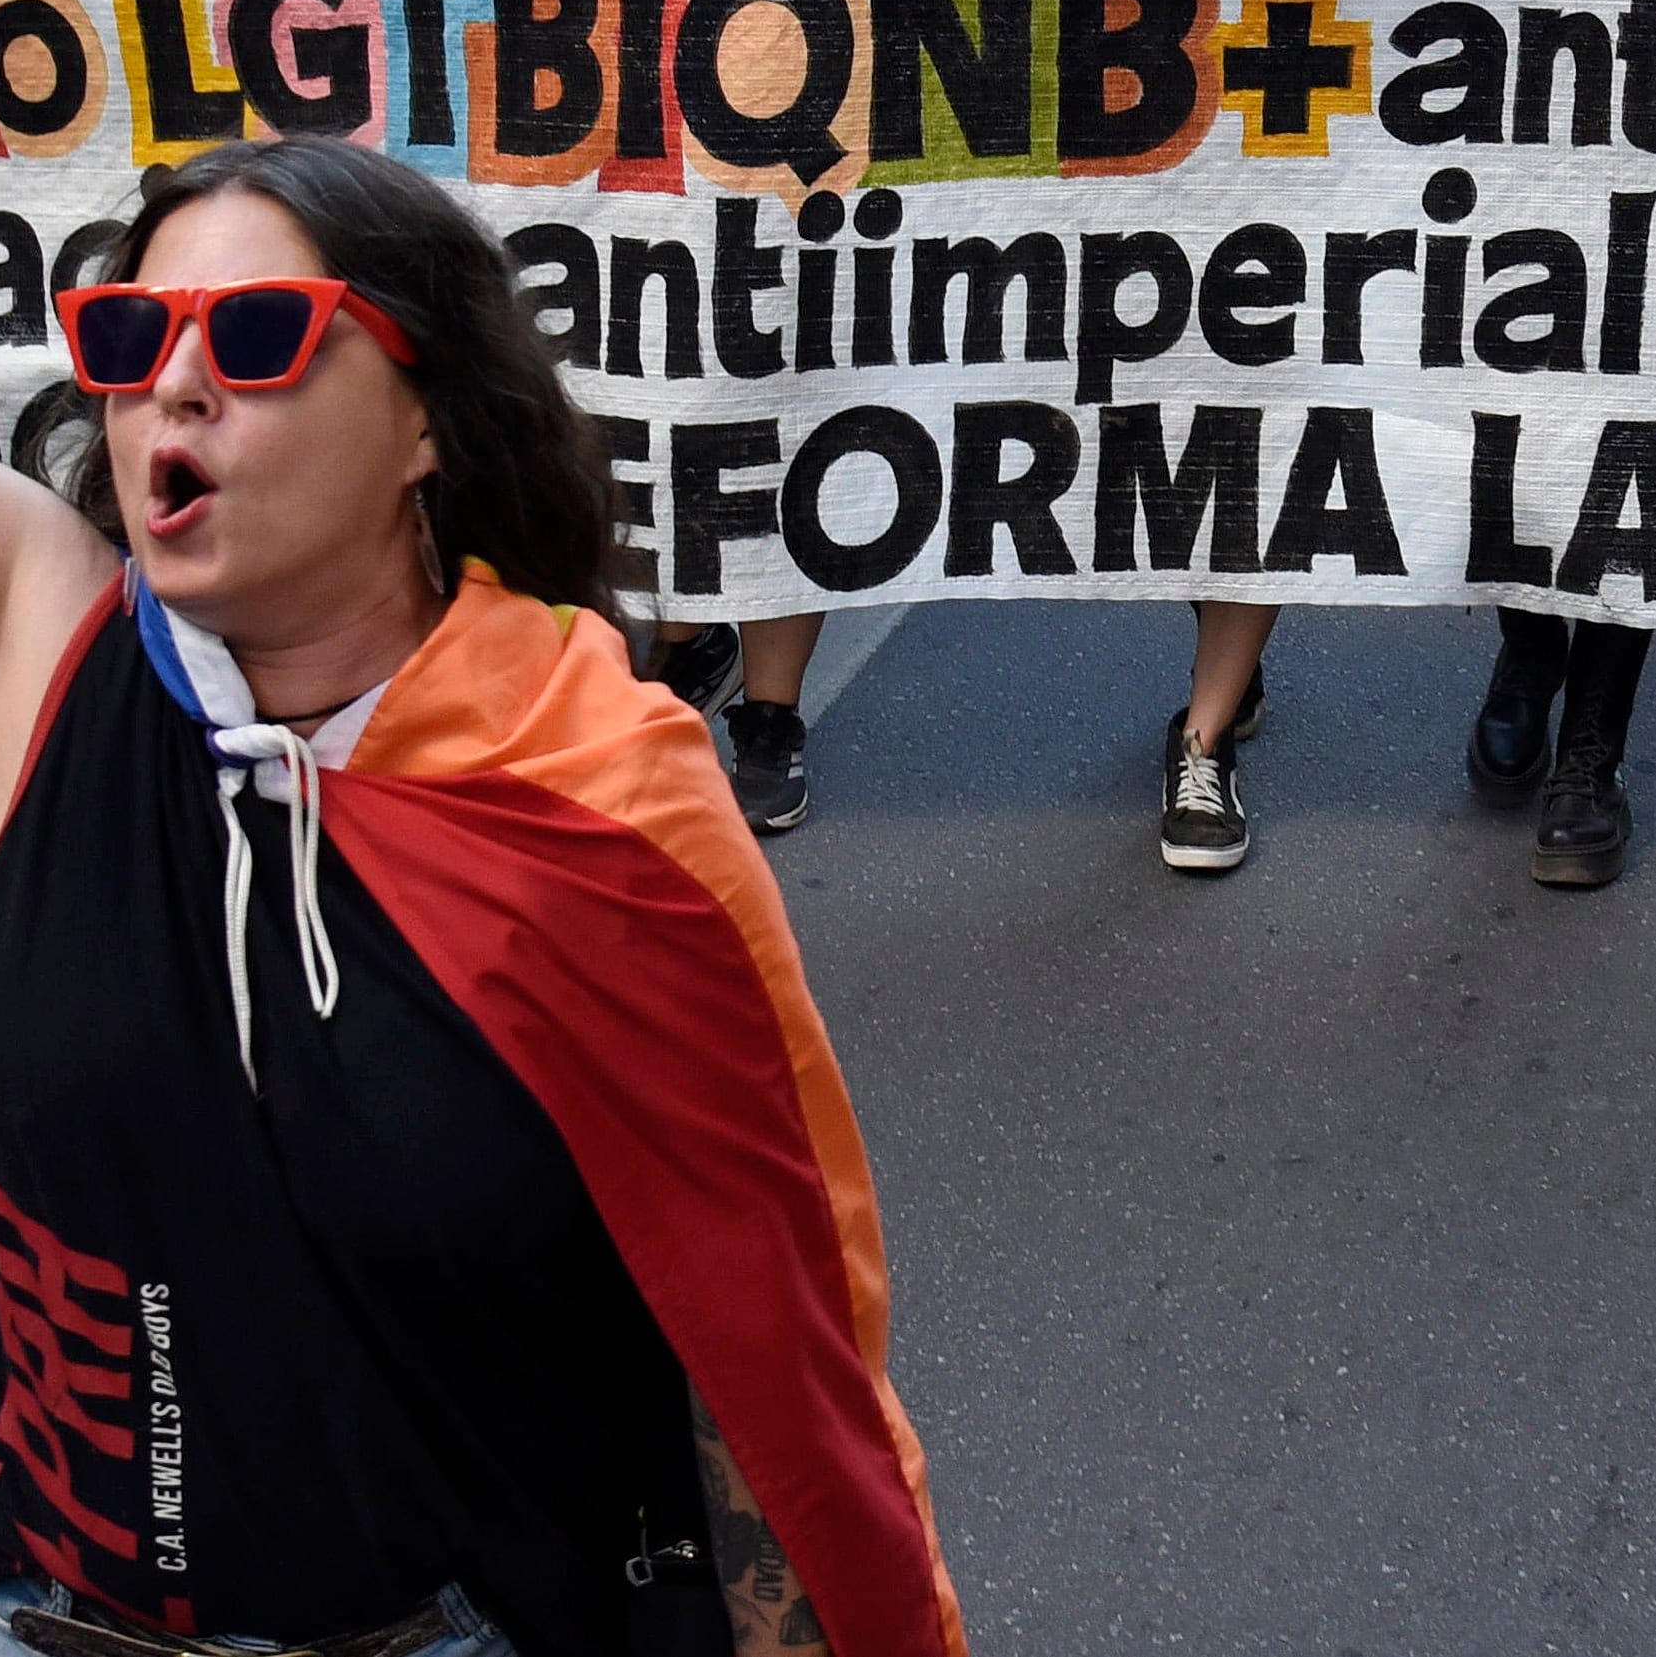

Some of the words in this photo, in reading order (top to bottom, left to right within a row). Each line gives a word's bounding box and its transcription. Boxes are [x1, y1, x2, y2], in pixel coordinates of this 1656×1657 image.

[593, 400, 1409, 595] EFORMA
[140, 1282, 171, 1349] BOYS
[150, 1352, 179, 1397] OLD
[151, 1401, 183, 1521] NEWELL'S
[156, 1526, 189, 1572] C.A.
